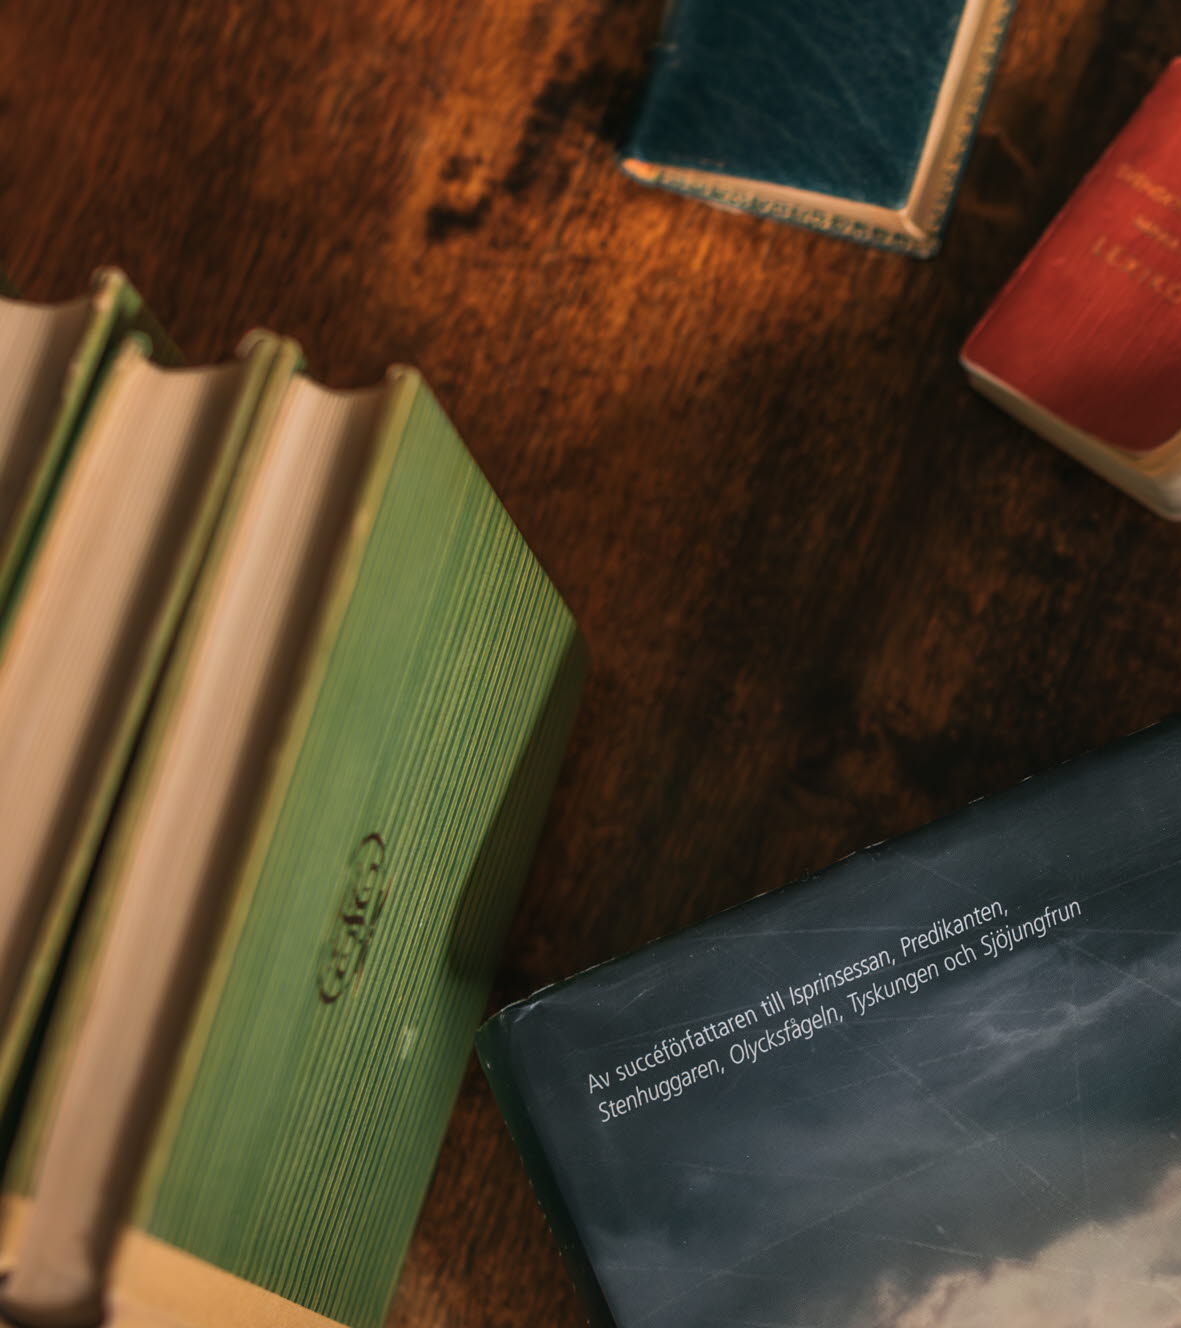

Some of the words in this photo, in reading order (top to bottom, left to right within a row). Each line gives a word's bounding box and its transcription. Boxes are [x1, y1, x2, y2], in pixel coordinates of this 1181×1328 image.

[588, 1072, 610, 1094] Av
[616, 1007, 759, 1082] succéförfattaren
[760, 991, 785, 1017] till
[788, 951, 896, 1006] Isprinsessan,
[899, 902, 1008, 958] Predikanten,
[598, 1058, 725, 1123] Stenhuggaren,
[729, 1007, 844, 1065] Olycksfågeln,
[847, 964, 940, 1016] Tyskungen
[944, 946, 977, 972] och
[980, 900, 1081, 958] Sjöjungfrun
